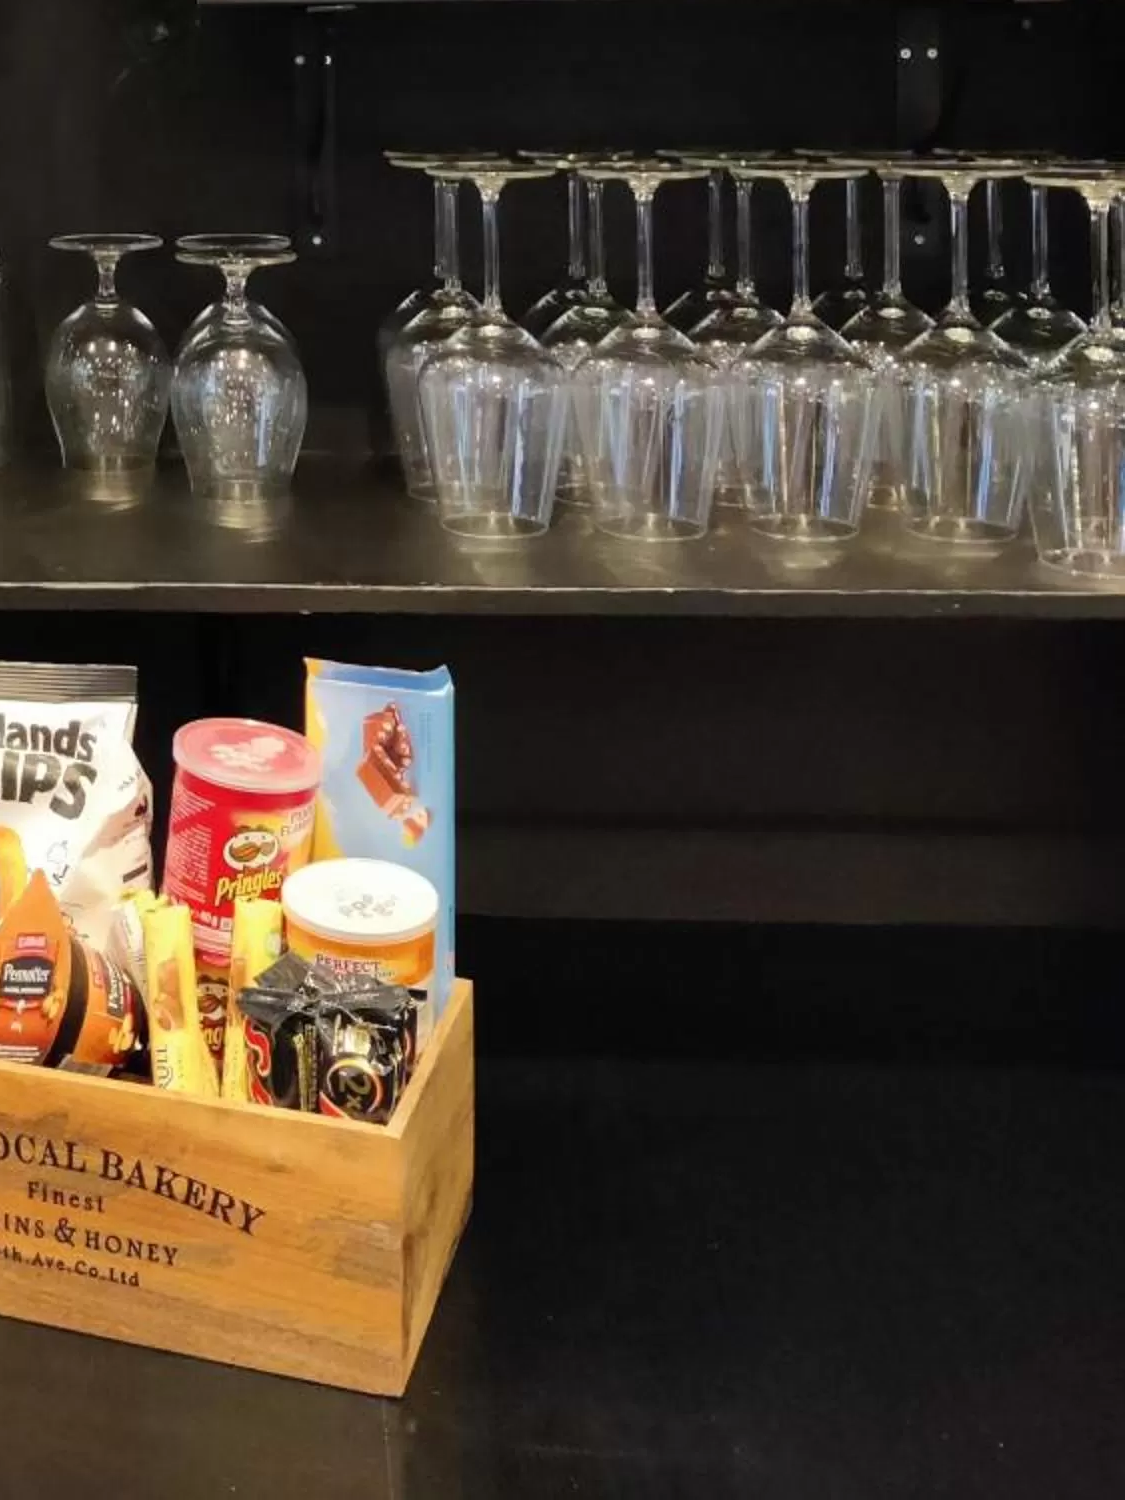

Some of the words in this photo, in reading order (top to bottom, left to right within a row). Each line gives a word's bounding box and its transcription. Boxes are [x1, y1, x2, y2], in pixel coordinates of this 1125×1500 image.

[215, 868, 284, 906] Pringles
[26, 1180, 106, 1213] Finest
[99, 1149, 267, 1236] BAKERY
[55, 1217, 76, 1247] &
[84, 1229, 178, 1267] HONEY
